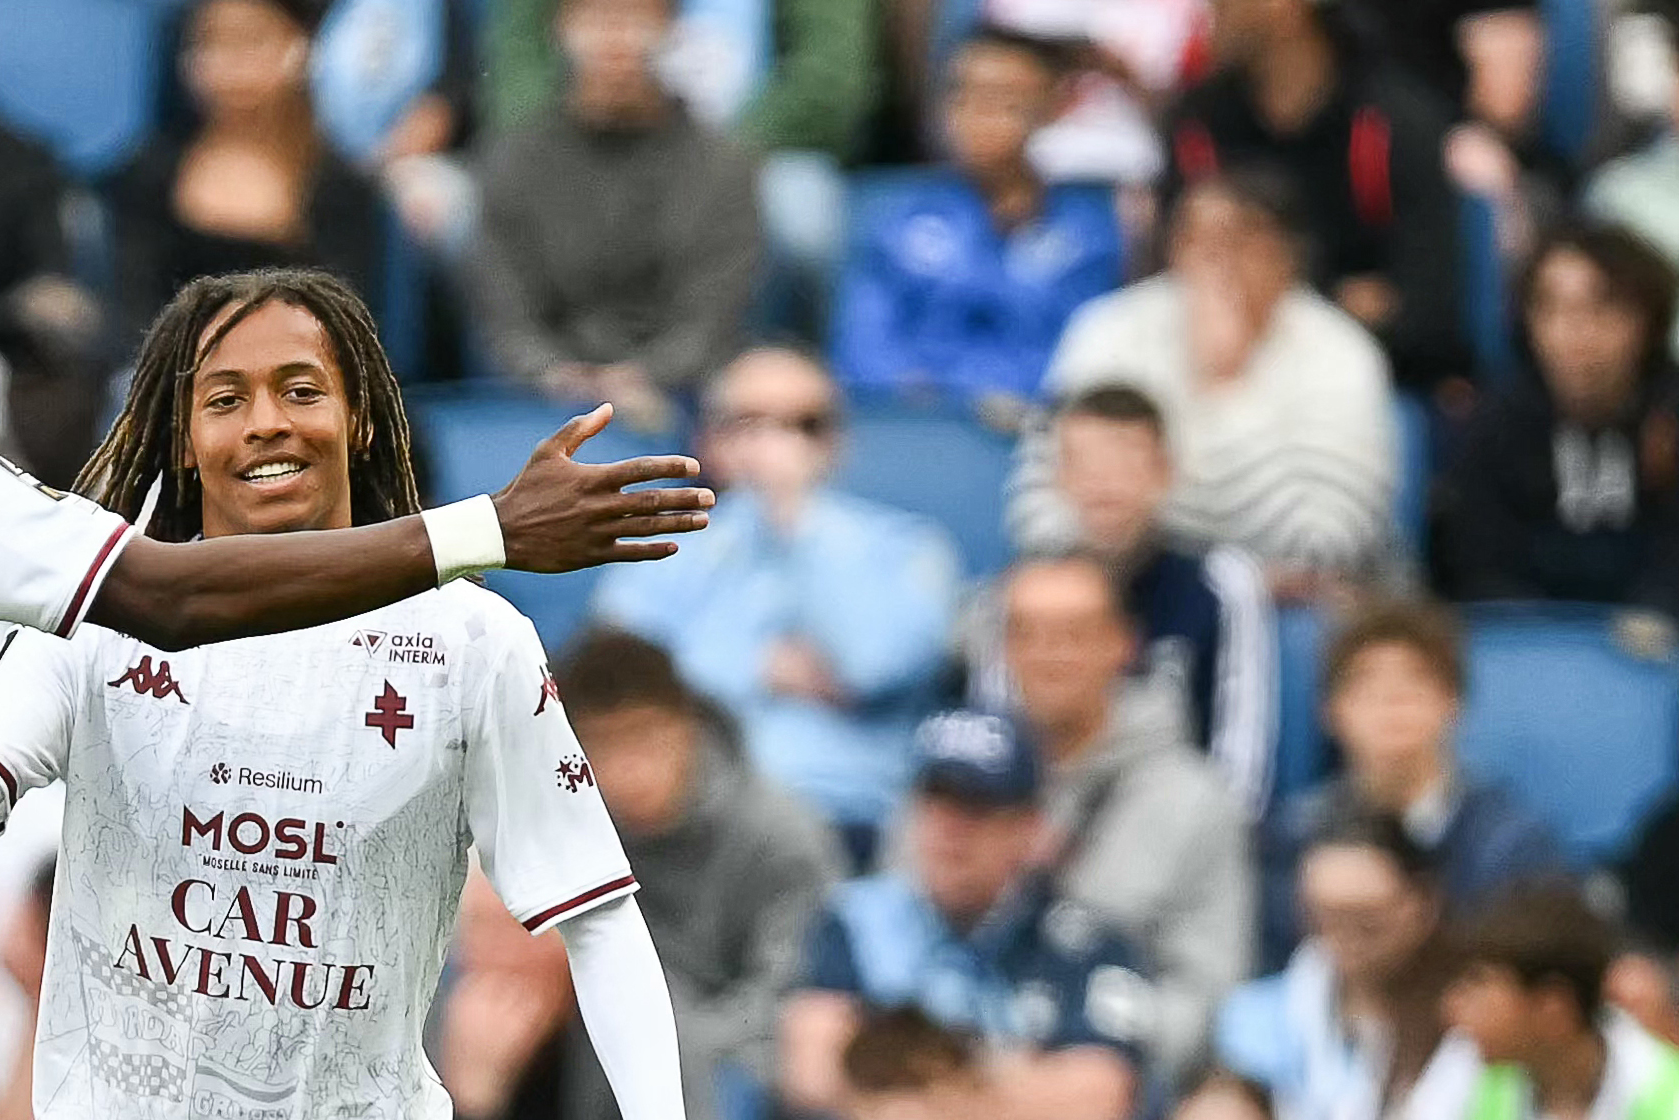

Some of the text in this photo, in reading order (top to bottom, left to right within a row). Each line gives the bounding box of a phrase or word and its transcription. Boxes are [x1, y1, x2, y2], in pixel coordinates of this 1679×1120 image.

[391, 632, 433, 649] axia
[388, 649, 445, 666] INTERIM
[238, 767, 323, 794] Resilium
[202, 855, 318, 880] MOSELLE SANS LIMITE
[171, 878, 319, 948] CAR
[113, 923, 375, 1011] AVENUE
